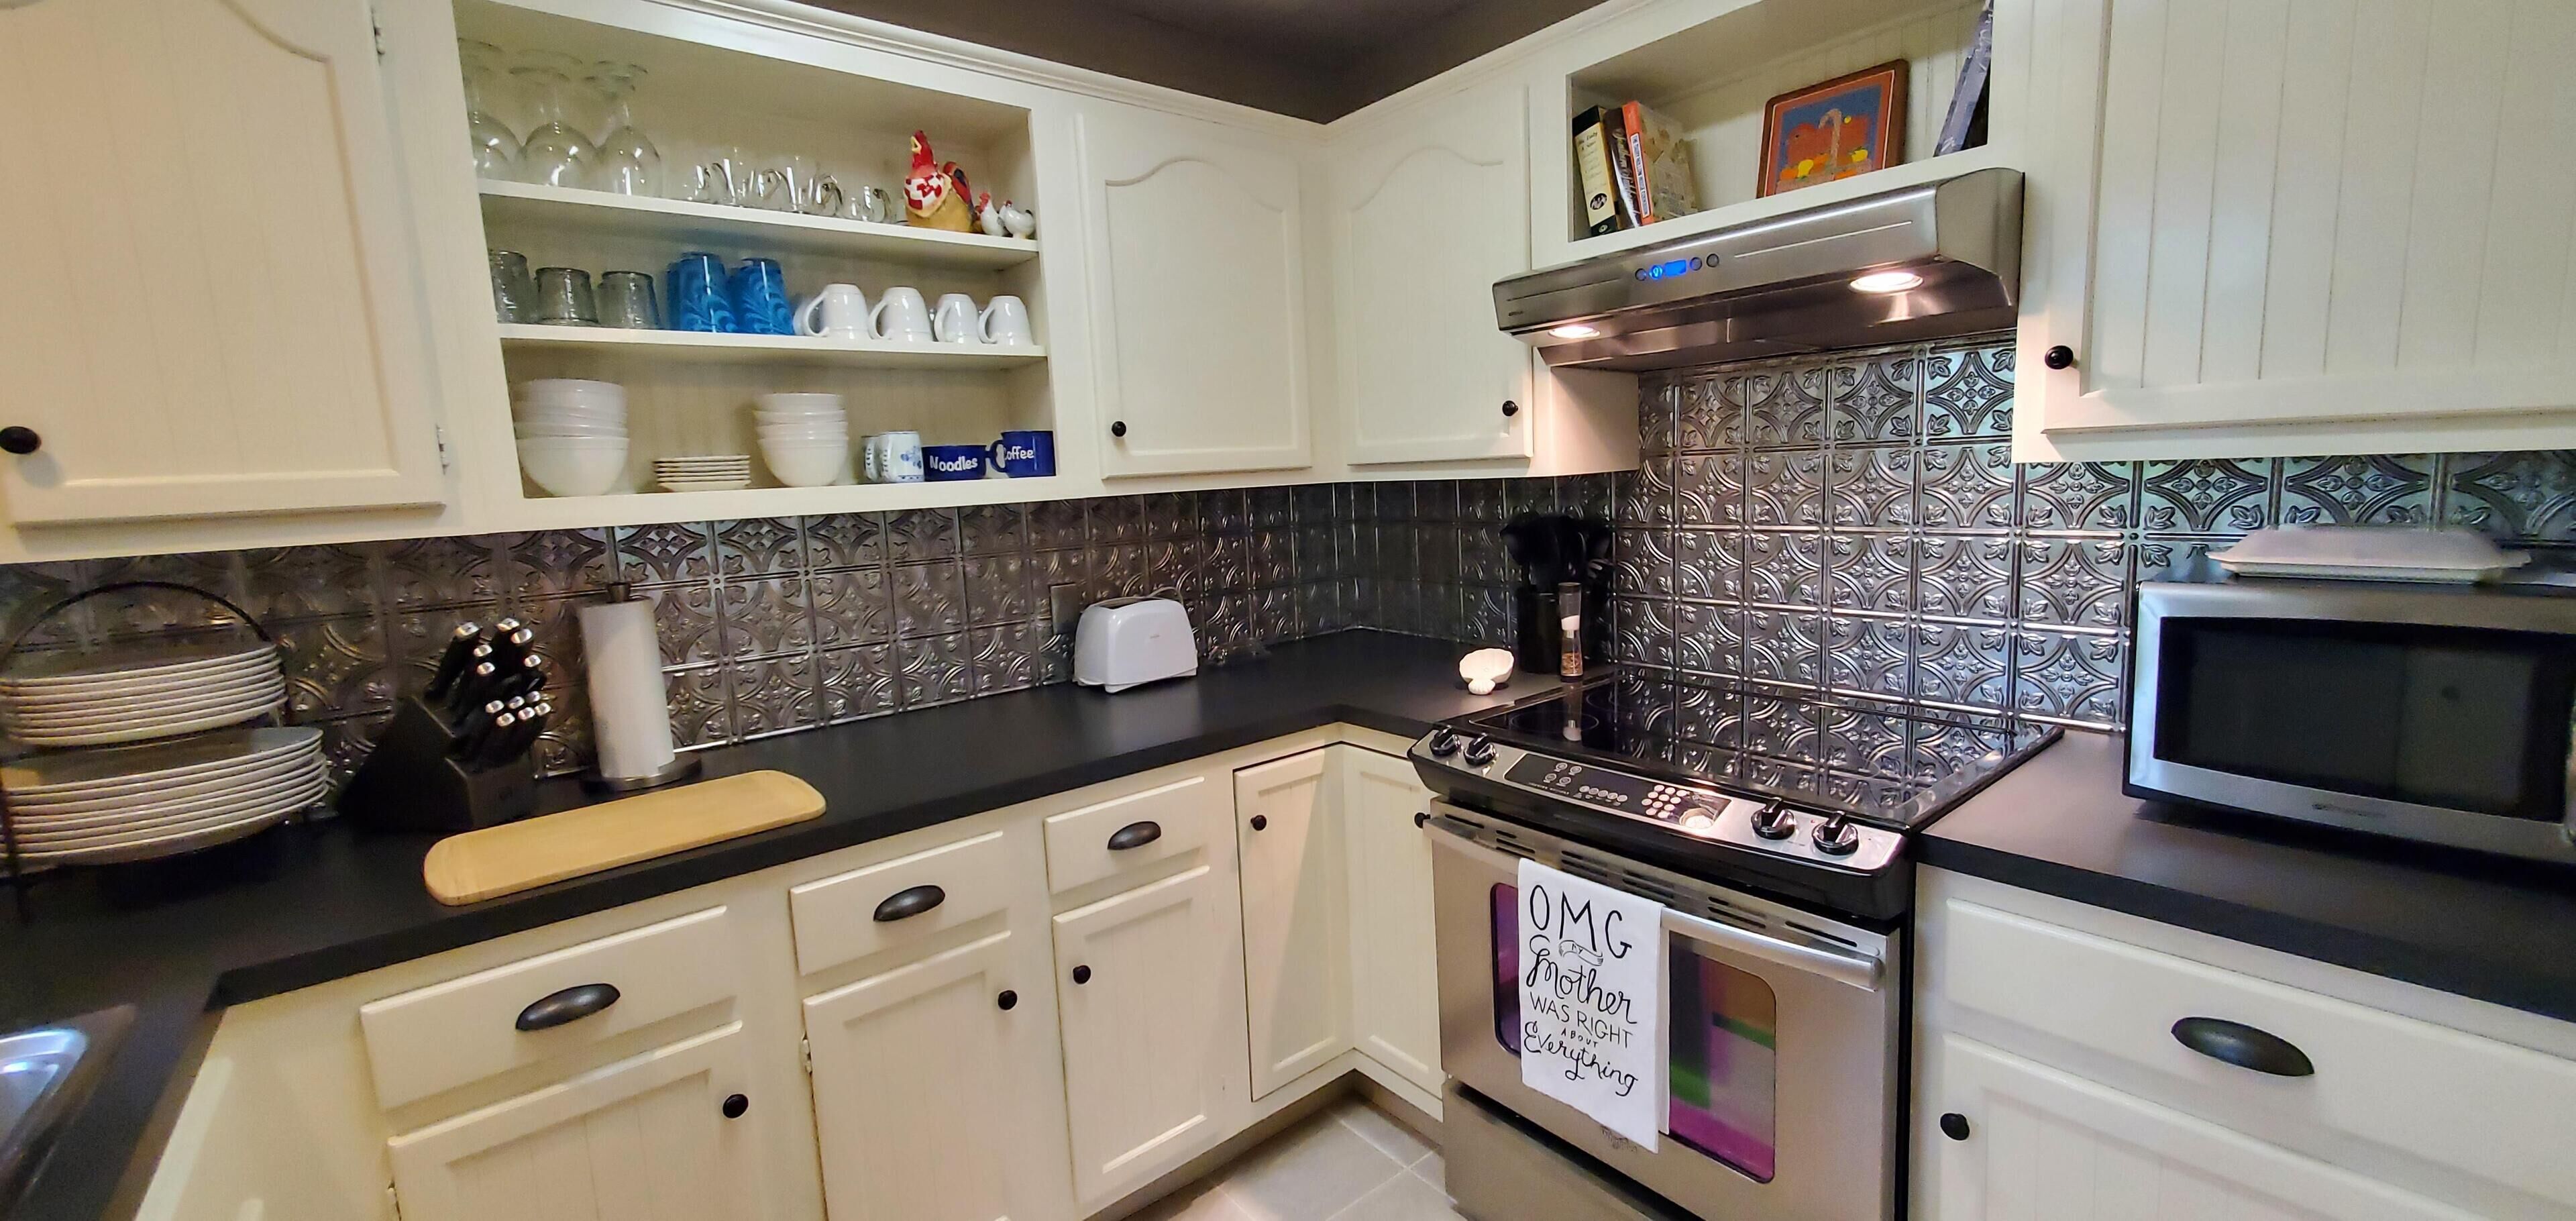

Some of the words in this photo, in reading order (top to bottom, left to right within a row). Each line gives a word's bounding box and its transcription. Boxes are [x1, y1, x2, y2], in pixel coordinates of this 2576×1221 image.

[929, 455, 978, 472] Noodles
[1529, 884, 1632, 959] OMG
[1526, 935, 1637, 1024] Mother
[1530, 992, 1570, 1023] WAS
[1577, 1010, 1633, 1049] RIGHT
[1561, 1028, 1599, 1047] ABOUT
[1523, 1020, 1638, 1096] Everything
